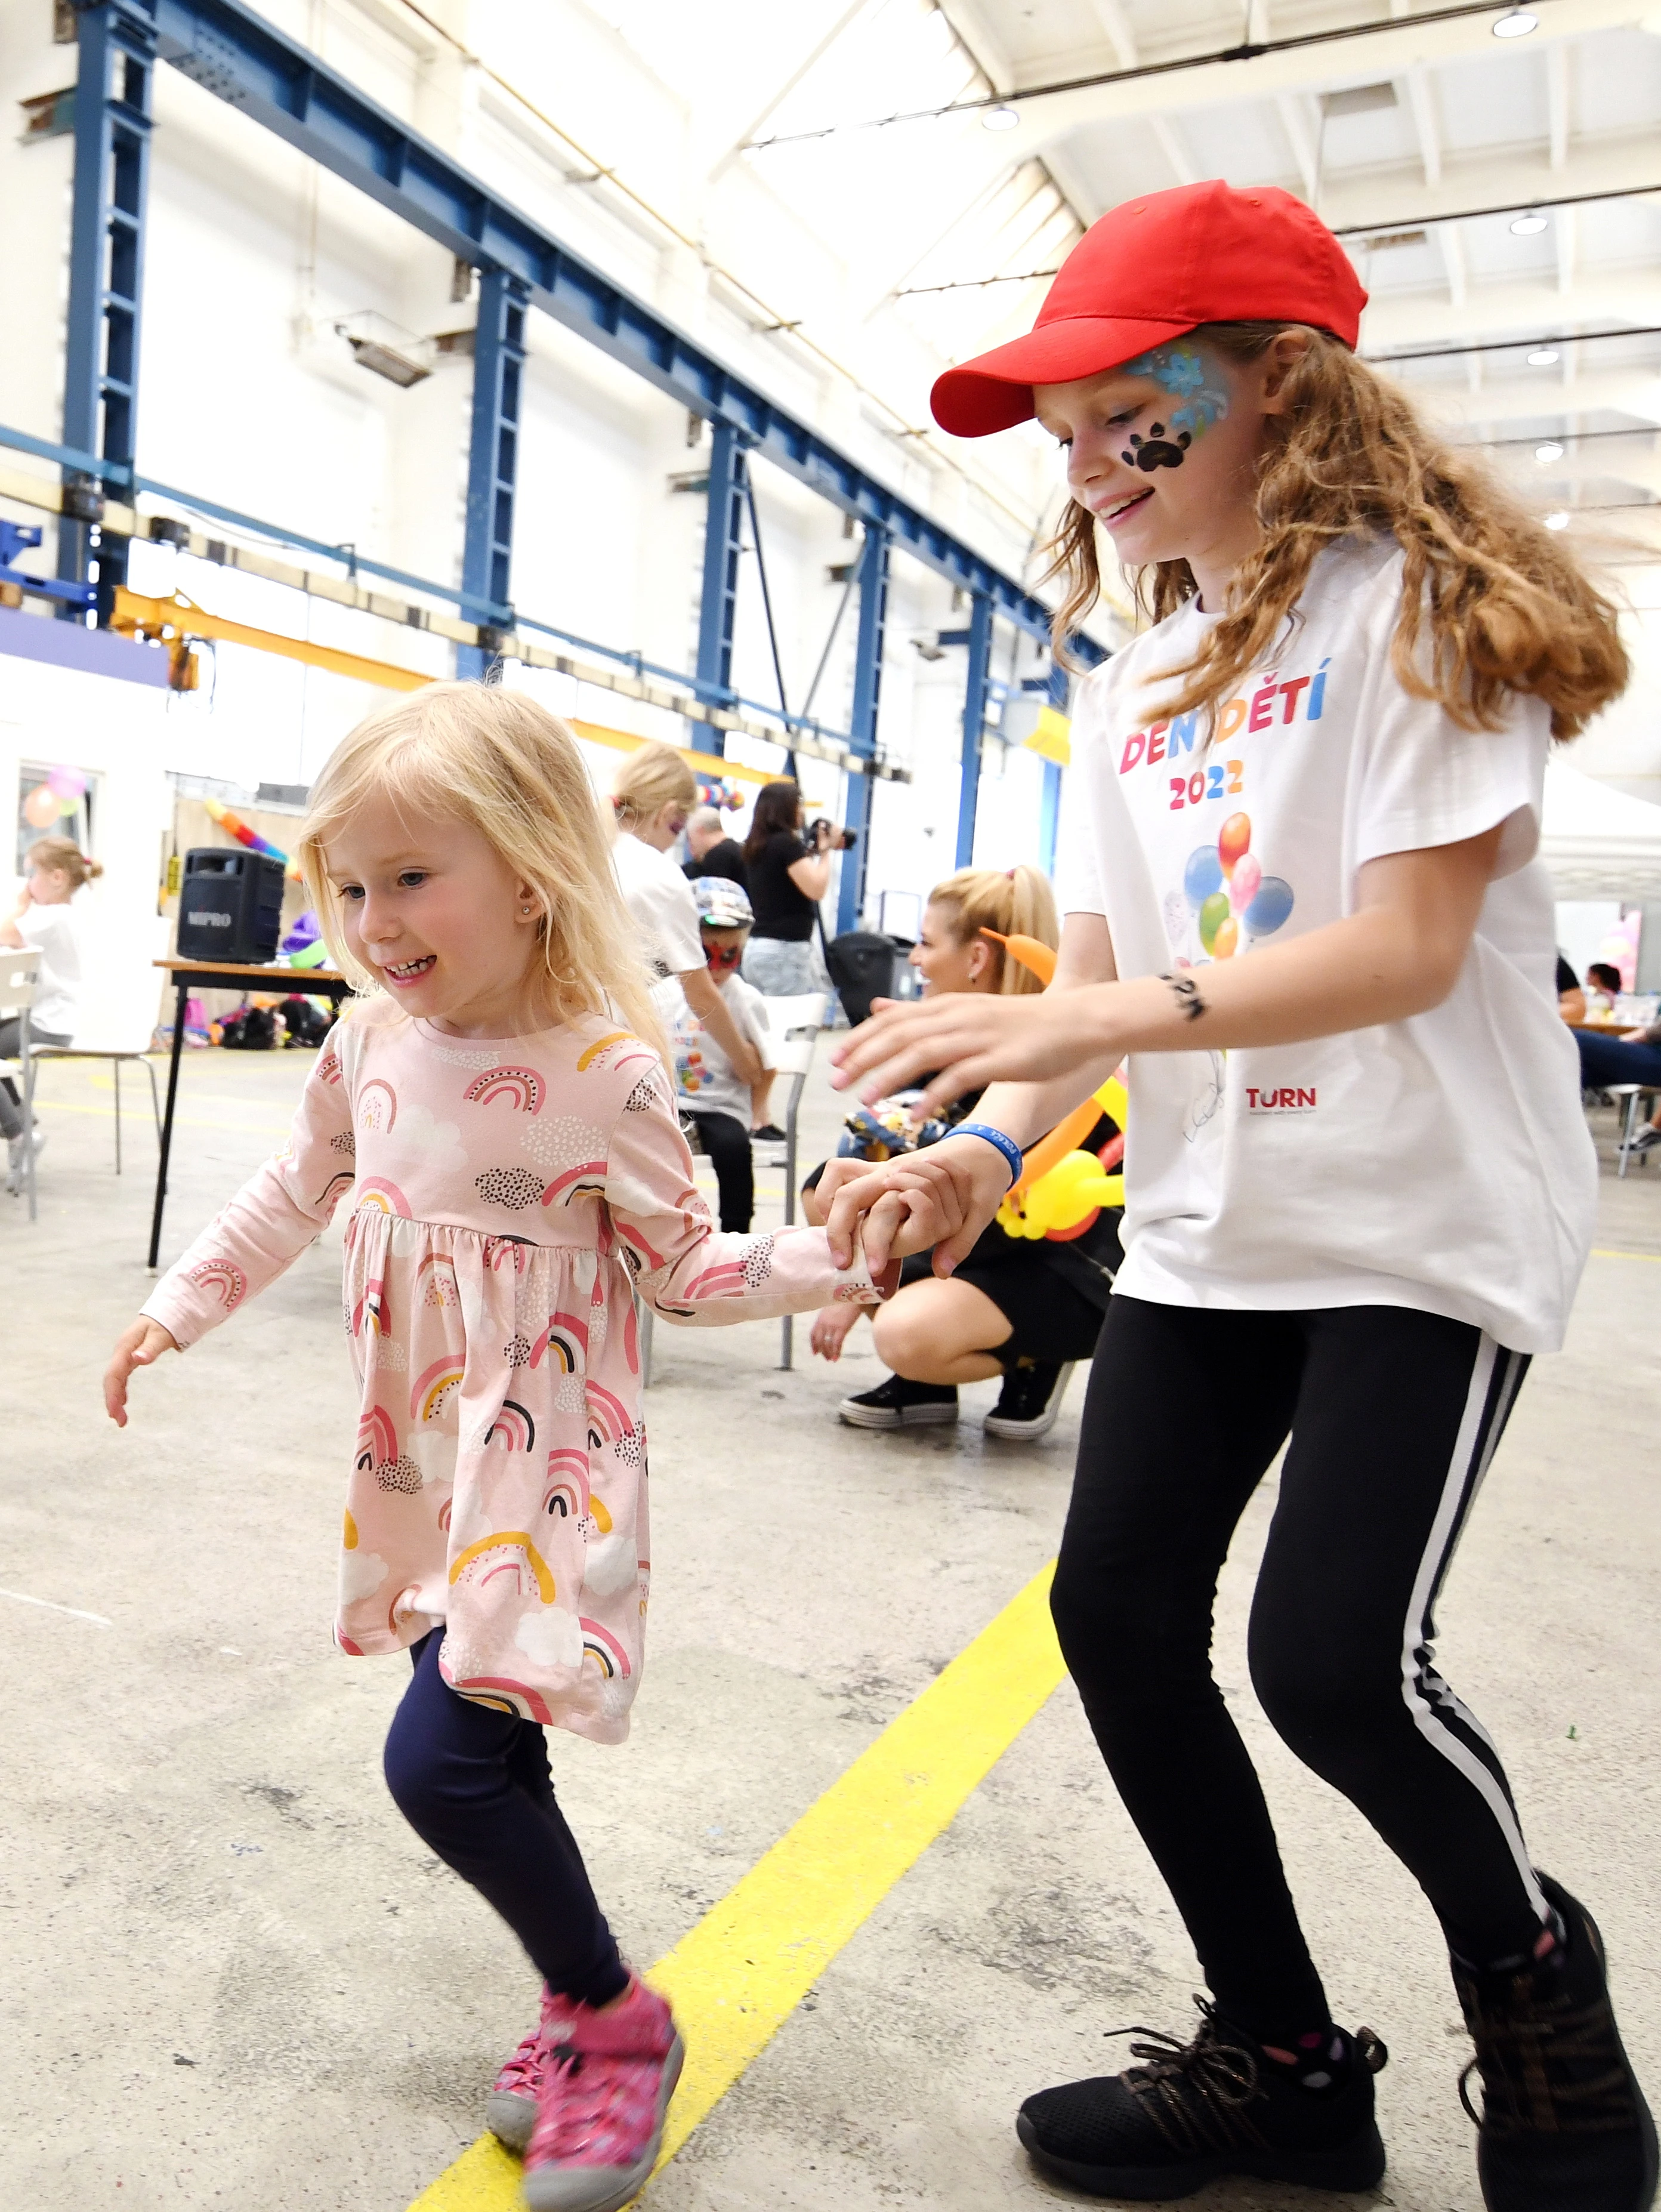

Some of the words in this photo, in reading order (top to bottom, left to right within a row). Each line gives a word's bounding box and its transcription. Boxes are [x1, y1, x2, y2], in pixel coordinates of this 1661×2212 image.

[1119, 709, 1199, 774] DEN
[1215, 658, 1331, 743] DĚTÍ
[1170, 760, 1243, 810] 2022
[1246, 1088, 1316, 1107] TURN
